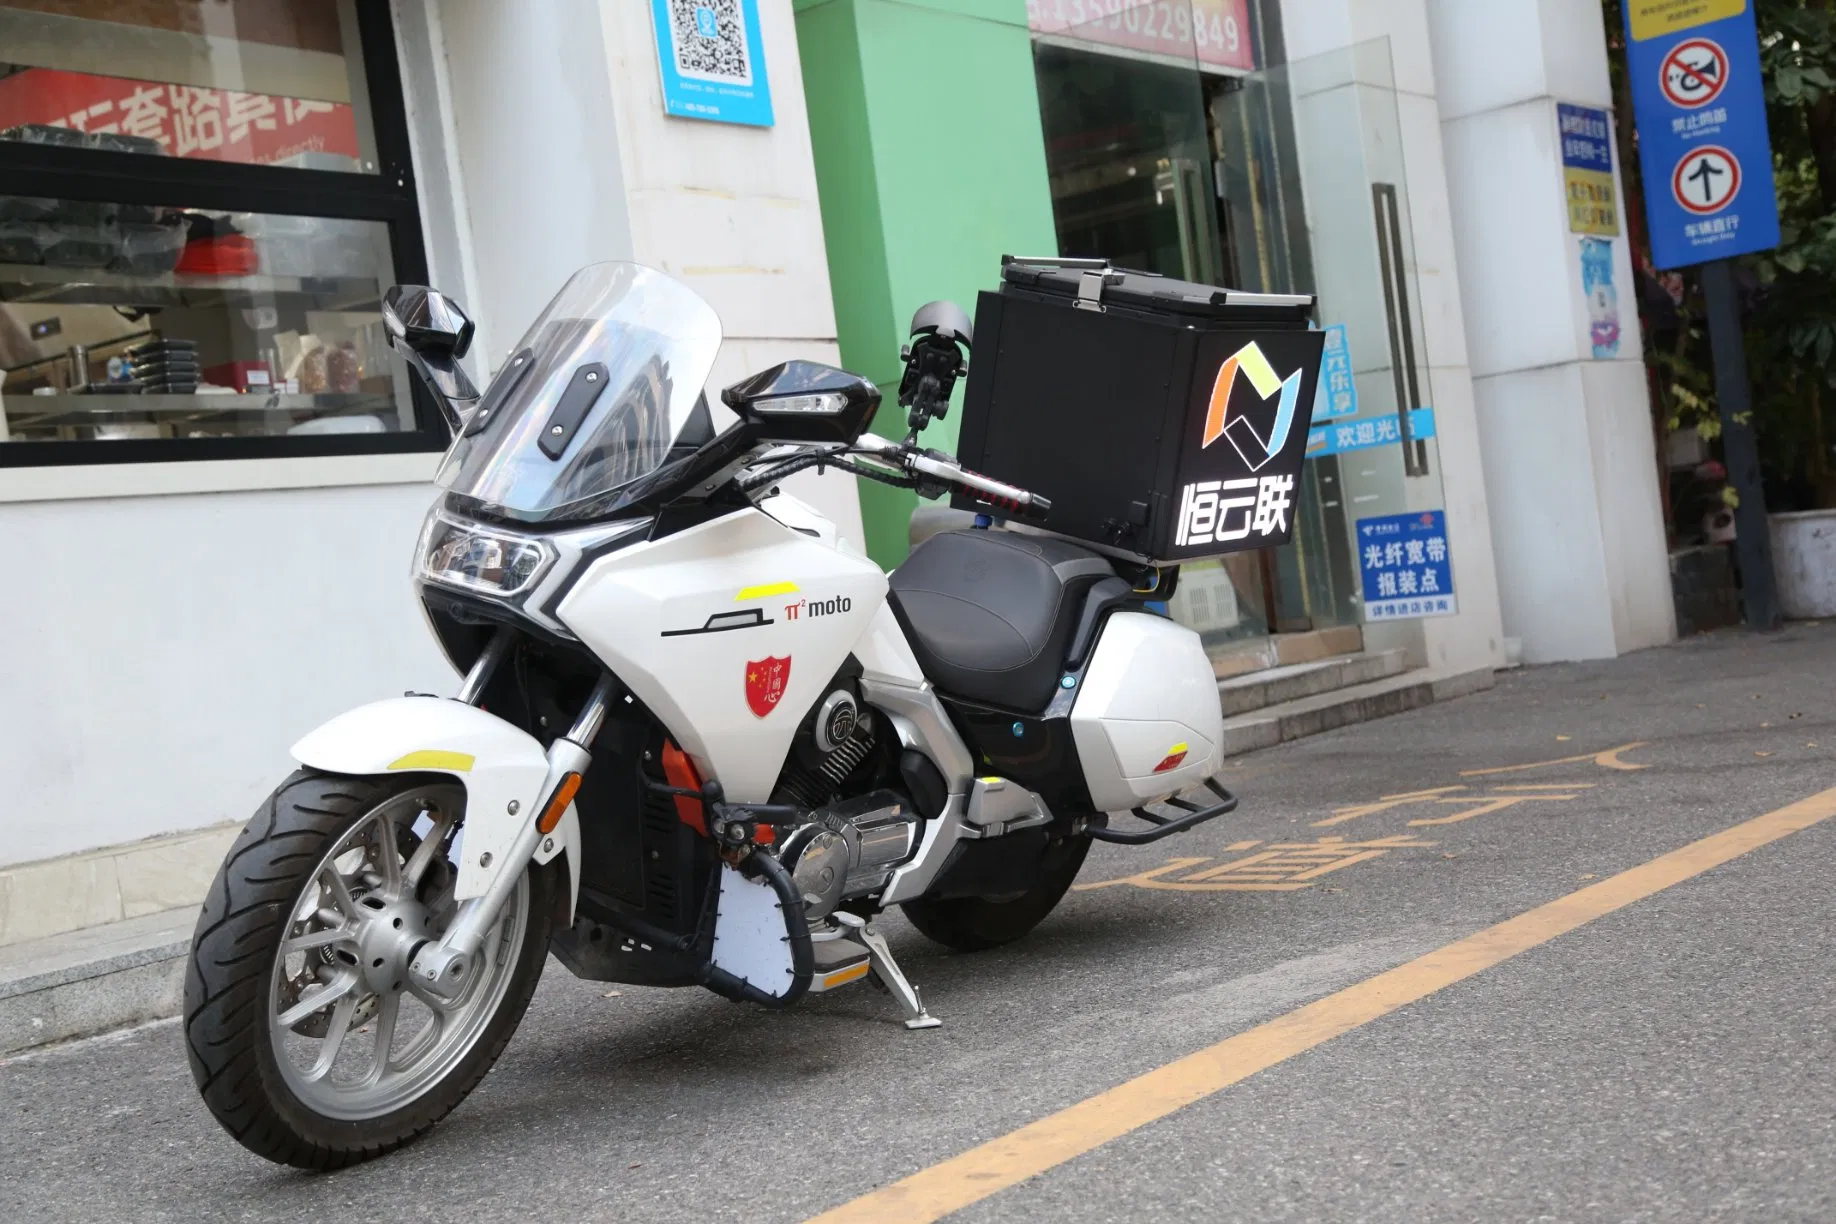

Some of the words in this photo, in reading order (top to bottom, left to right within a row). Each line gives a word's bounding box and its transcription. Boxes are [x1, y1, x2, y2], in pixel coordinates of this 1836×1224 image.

[1175, 473, 1294, 547] 恒云联
[1364, 536, 1446, 570] 光纤宽带
[1377, 567, 1440, 597] 报装点
[808, 595, 852, 618] moto
[1372, 600, 1449, 617] 详情进店咨询
